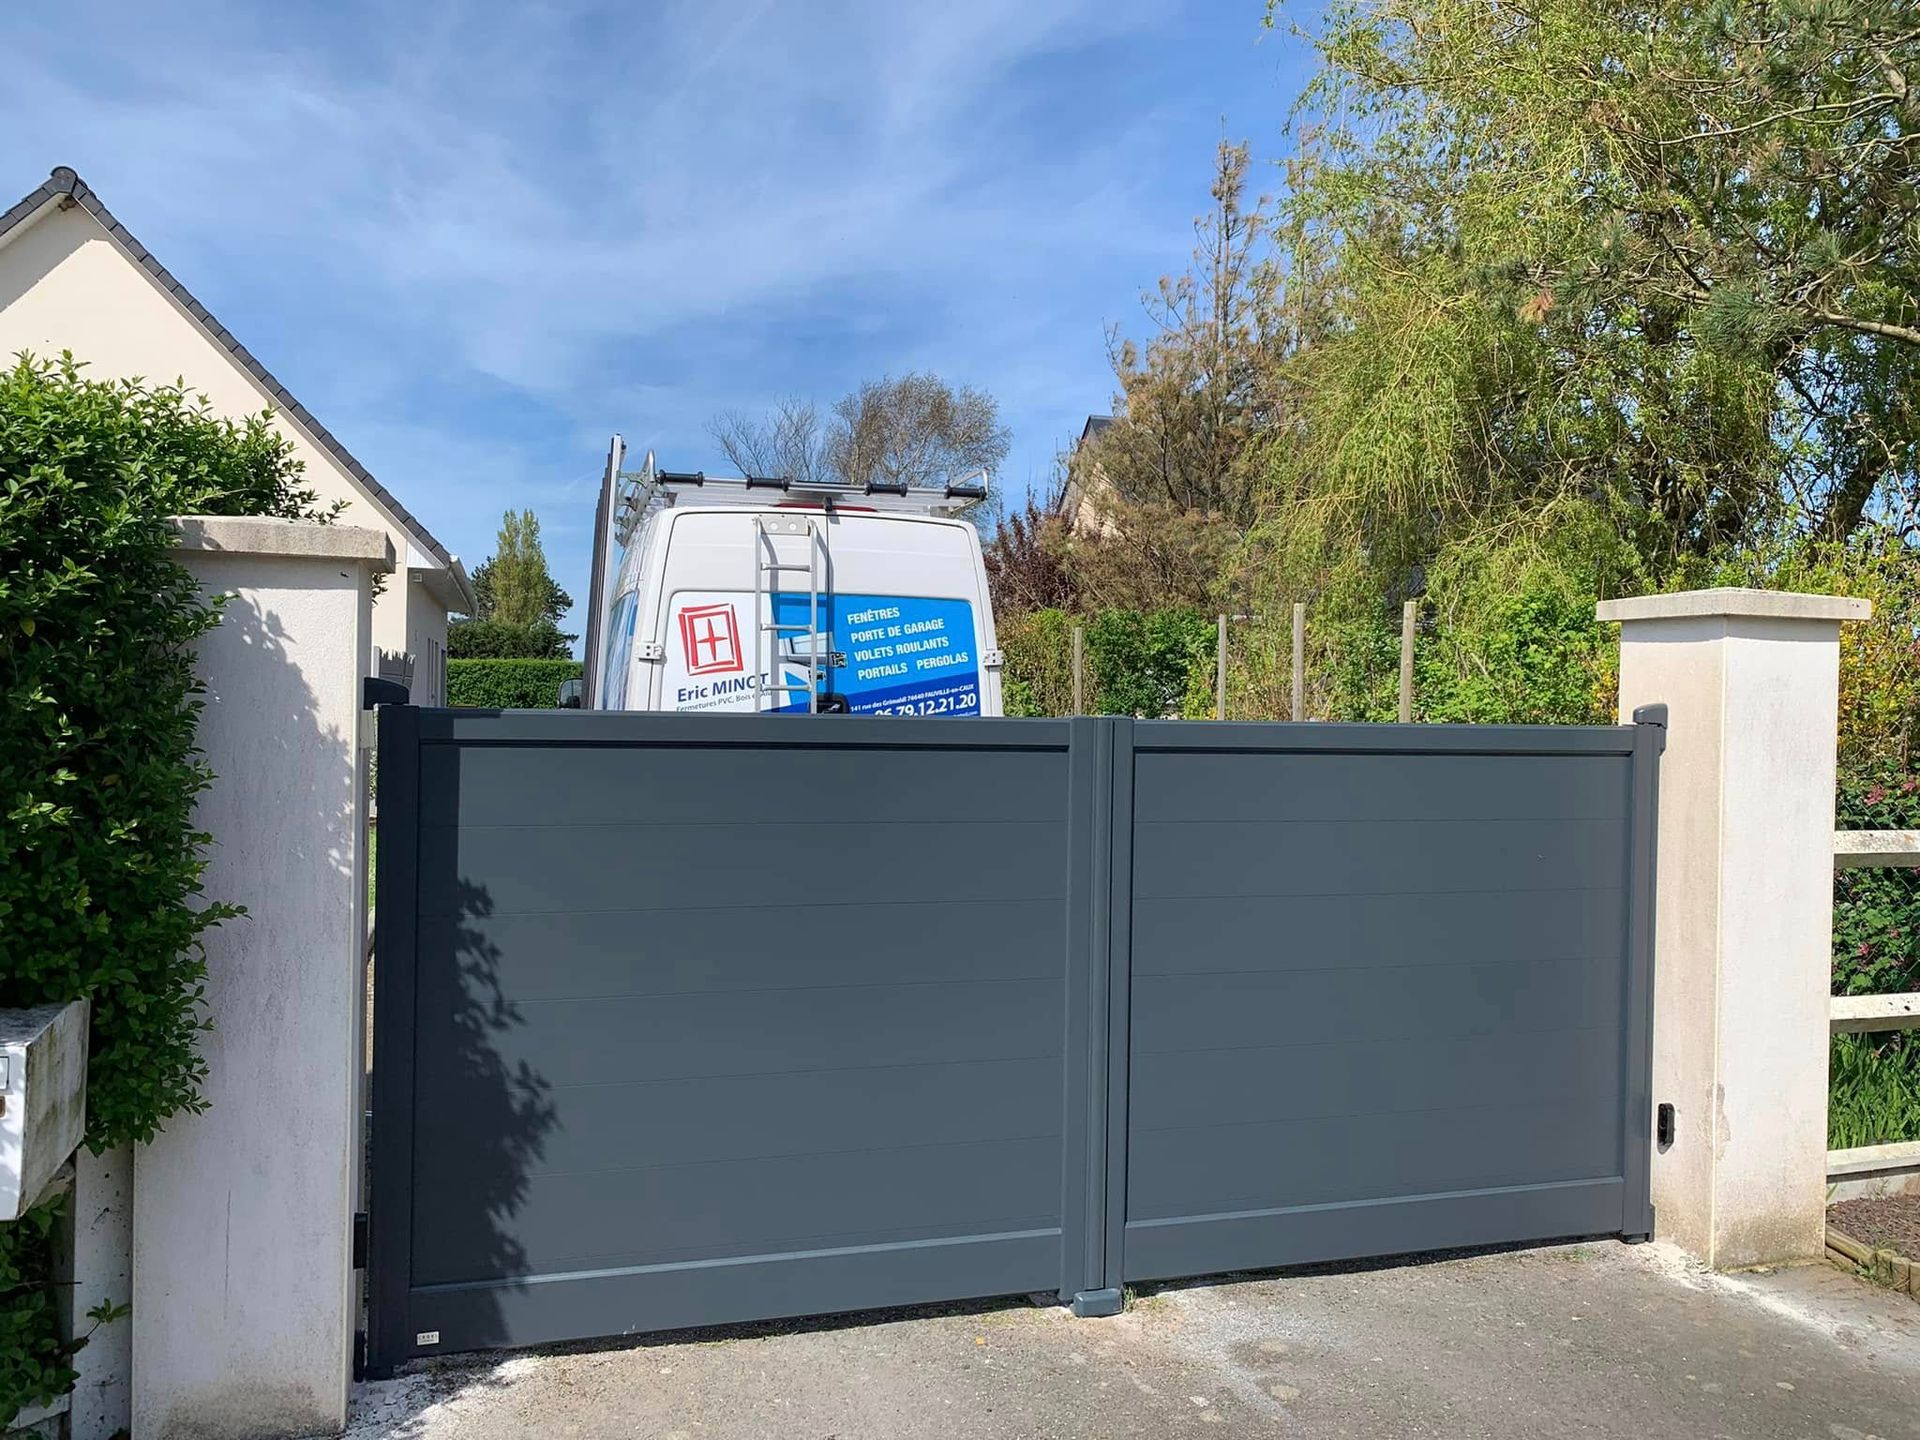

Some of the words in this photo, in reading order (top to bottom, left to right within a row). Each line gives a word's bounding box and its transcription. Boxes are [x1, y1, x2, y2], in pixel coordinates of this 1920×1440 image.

[847, 607, 900, 625] FENÊTRES
[851, 630, 885, 643] PORTE
[888, 626, 902, 638] DE
[904, 618, 945, 635] GARAGE
[854, 646, 894, 662] VOLETS
[896, 636, 950, 655] ROULANTS
[857, 663, 908, 680] PORTAILS
[916, 652, 969, 670] PERGOLAS
[677, 685, 708, 702] Eric
